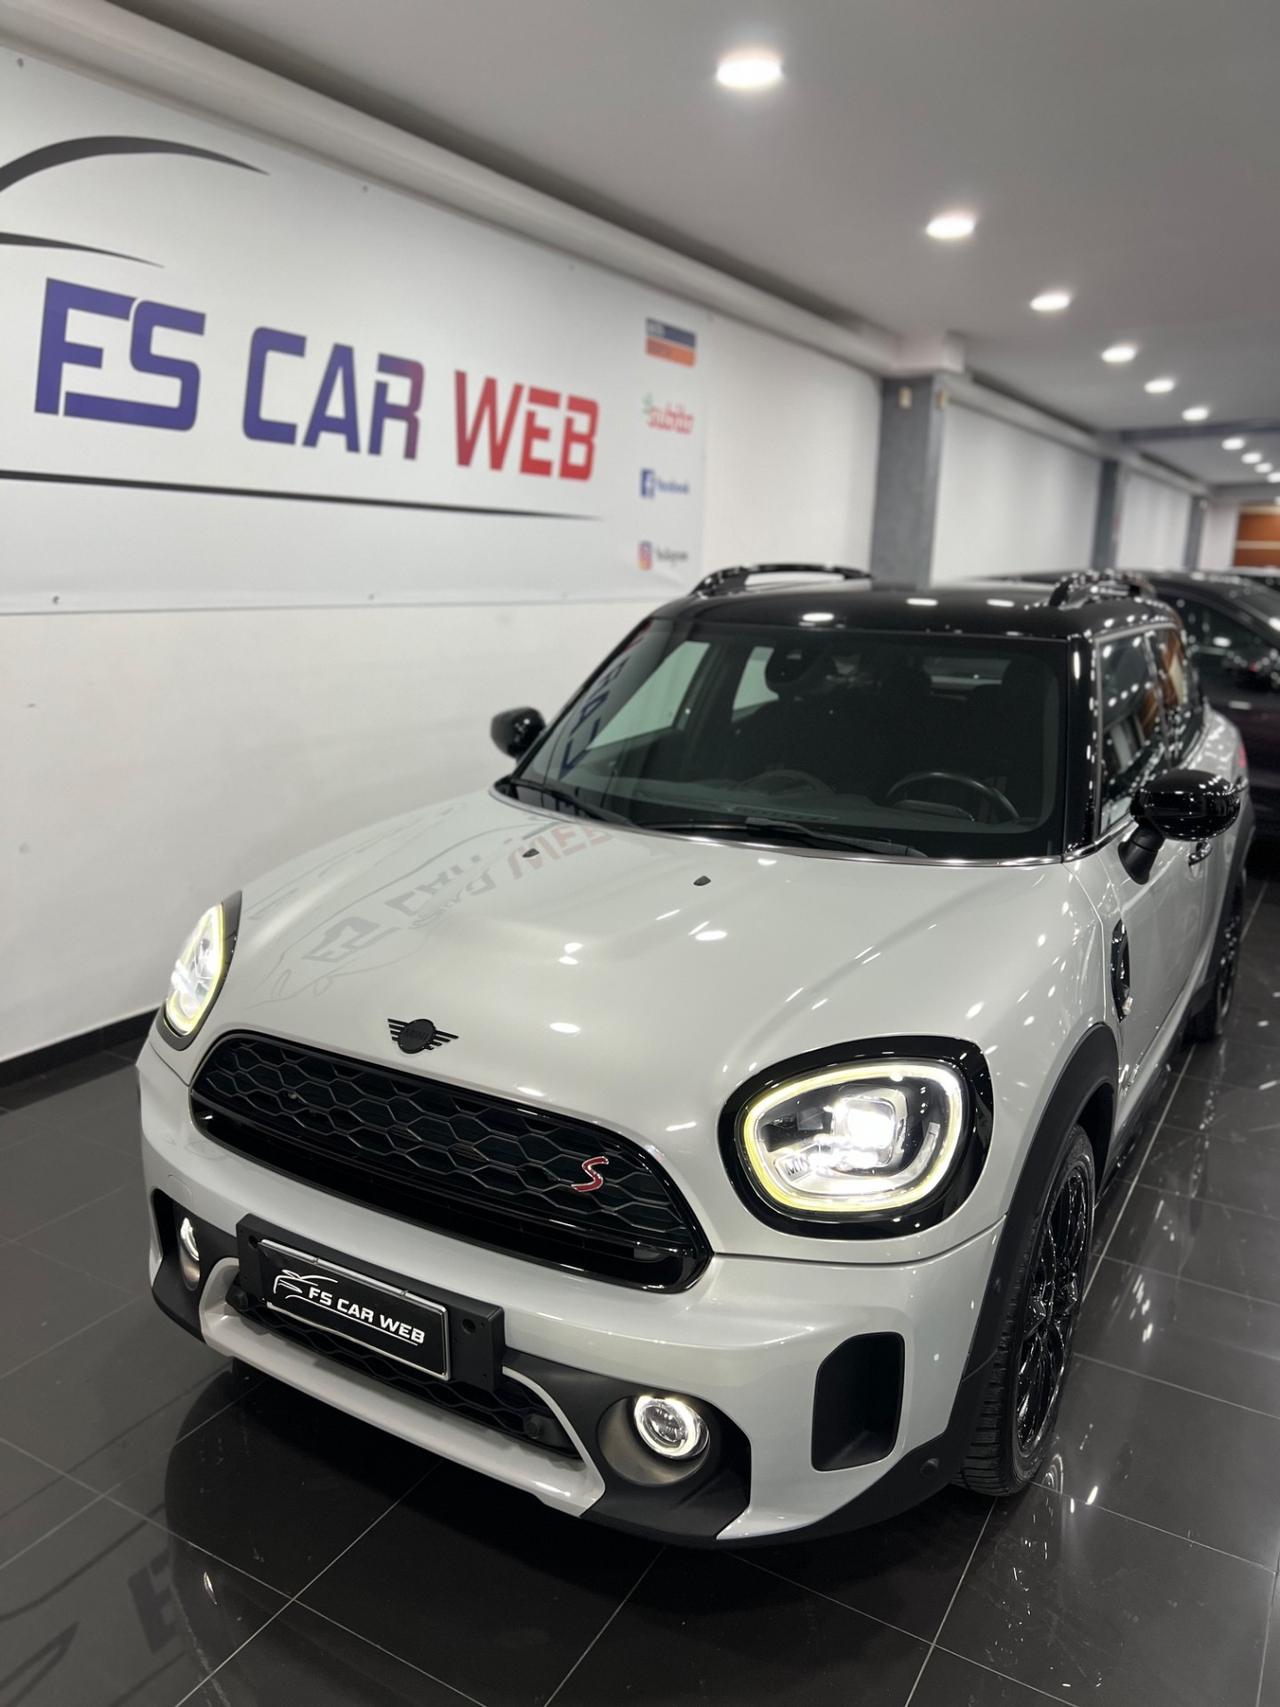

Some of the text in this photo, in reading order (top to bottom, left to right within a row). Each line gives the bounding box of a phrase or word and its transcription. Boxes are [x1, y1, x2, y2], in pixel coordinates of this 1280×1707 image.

[242, 326, 425, 461] CAR
[454, 369, 600, 482] WEB
[571, 1155, 609, 1192] S
[308, 1286, 426, 1344] FS CAR WEB
